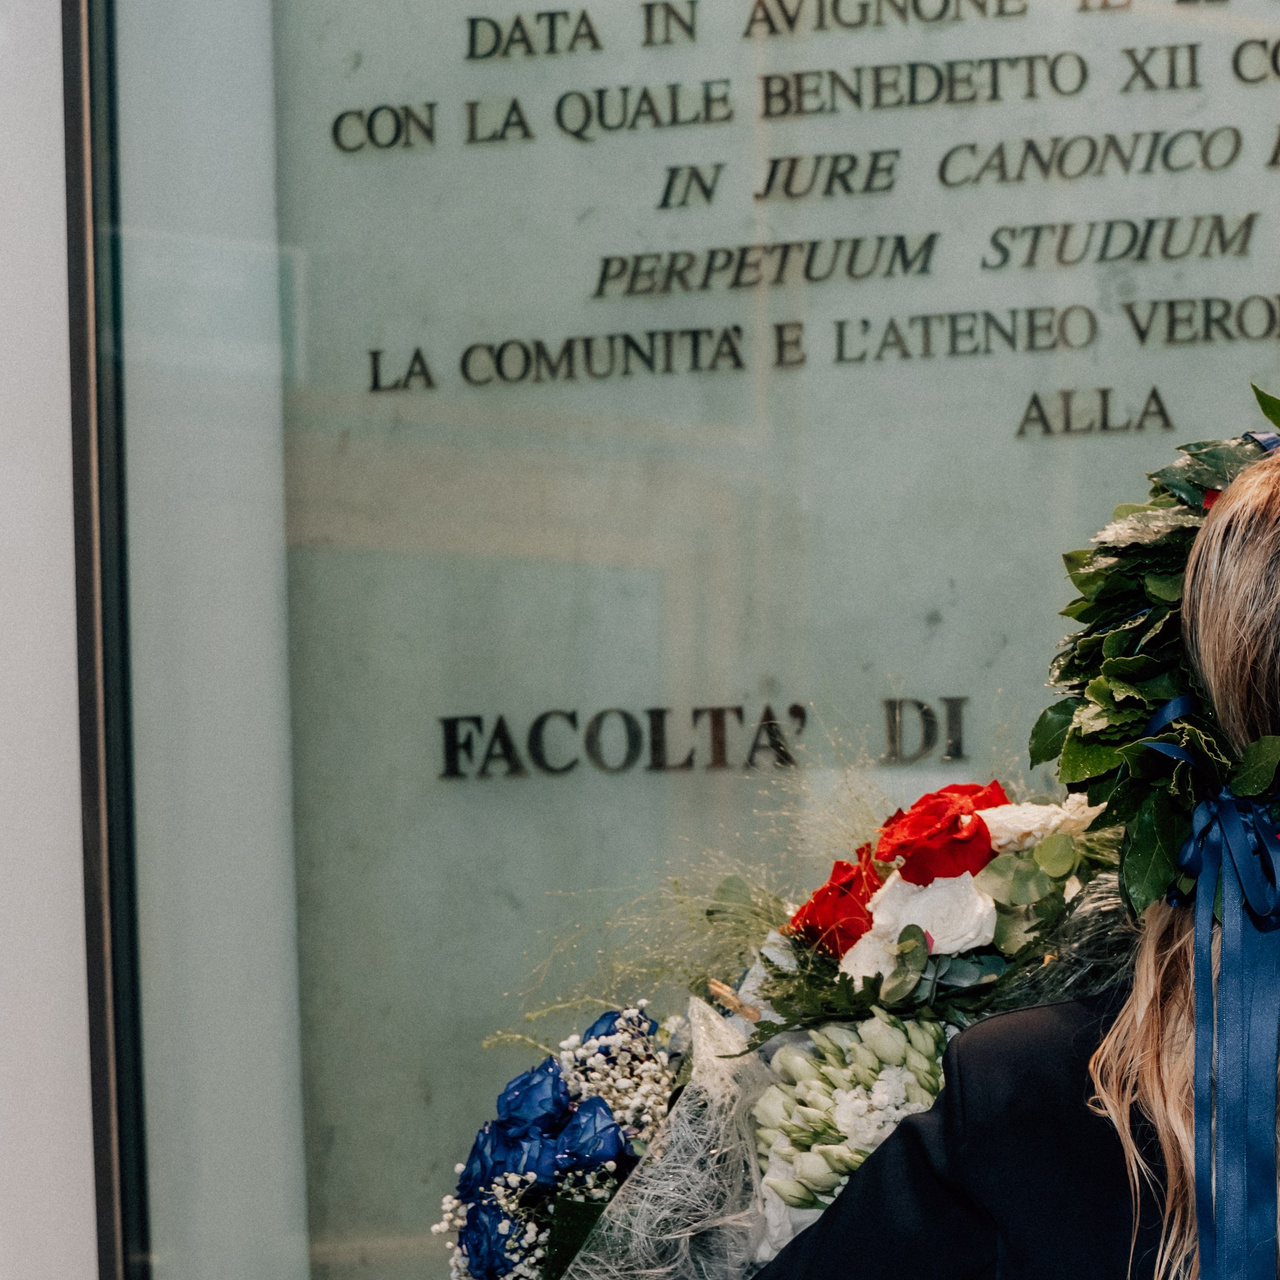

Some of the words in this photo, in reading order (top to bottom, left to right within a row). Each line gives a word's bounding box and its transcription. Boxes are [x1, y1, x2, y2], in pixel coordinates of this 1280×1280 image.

[465, 11, 602, 60] DATA
[642, 0, 698, 46] IN
[331, 102, 436, 153] CON
[464, 98, 531, 144] LA
[554, 80, 734, 141] QUALE
[760, 53, 1088, 120] BENEDETTO
[1120, 44, 1202, 93] XII
[656, 163, 724, 210] IN
[754, 150, 901, 201] JURE
[937, 125, 1243, 188] CANONICO
[592, 232, 939, 300] PERPETUUM
[981, 212, 1260, 271] STUDIUM
[368, 348, 437, 394] LA
[772, 322, 807, 369] E
[833, 305, 1097, 364] L'ATENEO
[1016, 387, 1174, 438] ALLA
[881, 696, 970, 765] DI
